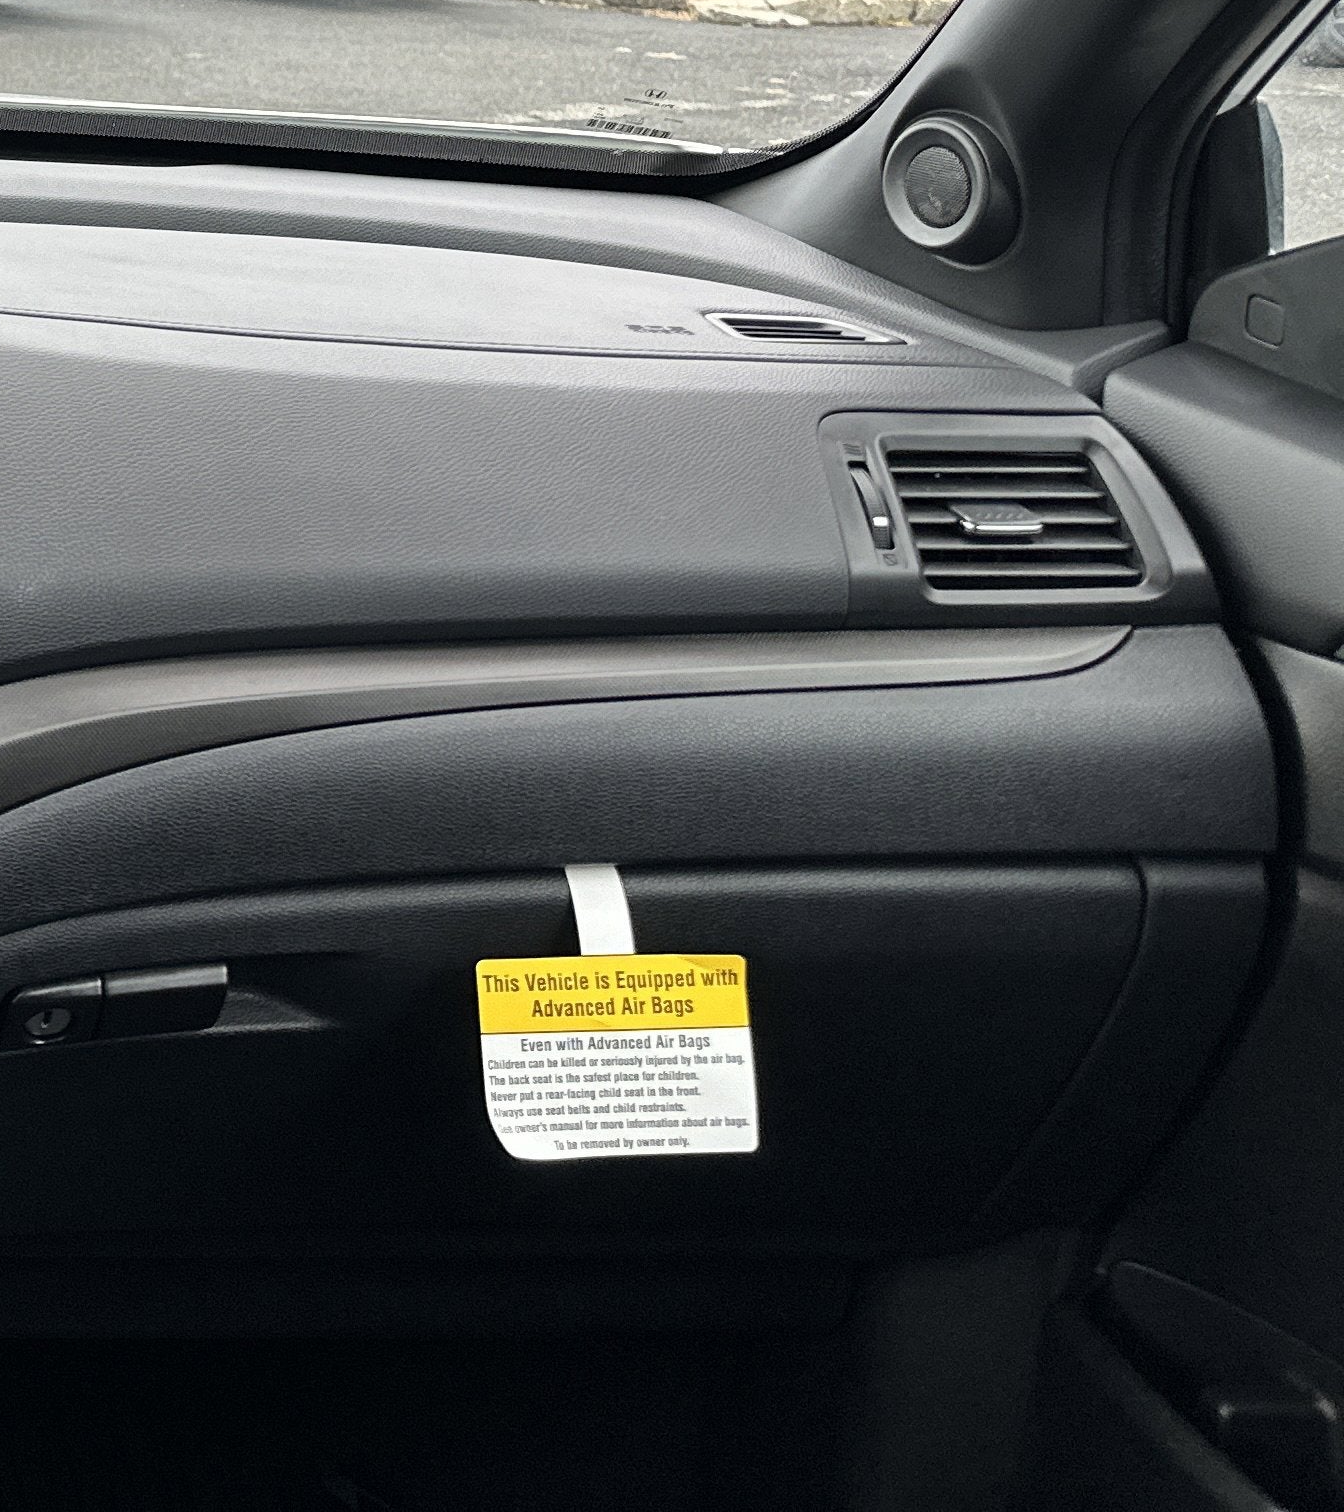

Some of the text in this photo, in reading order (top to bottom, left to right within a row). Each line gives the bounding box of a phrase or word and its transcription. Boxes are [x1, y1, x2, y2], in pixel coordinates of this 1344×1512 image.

[482, 968, 739, 992] This Vehicle is Equipped with
[531, 997, 694, 1017] Advanced Air Bags
[520, 1034, 711, 1052] Even with Advanced Air Bags
[487, 1052, 745, 1070] Children can be killed or seriously injured by the air bag.
[489, 1070, 700, 1086] The back seat is the safest place for children.
